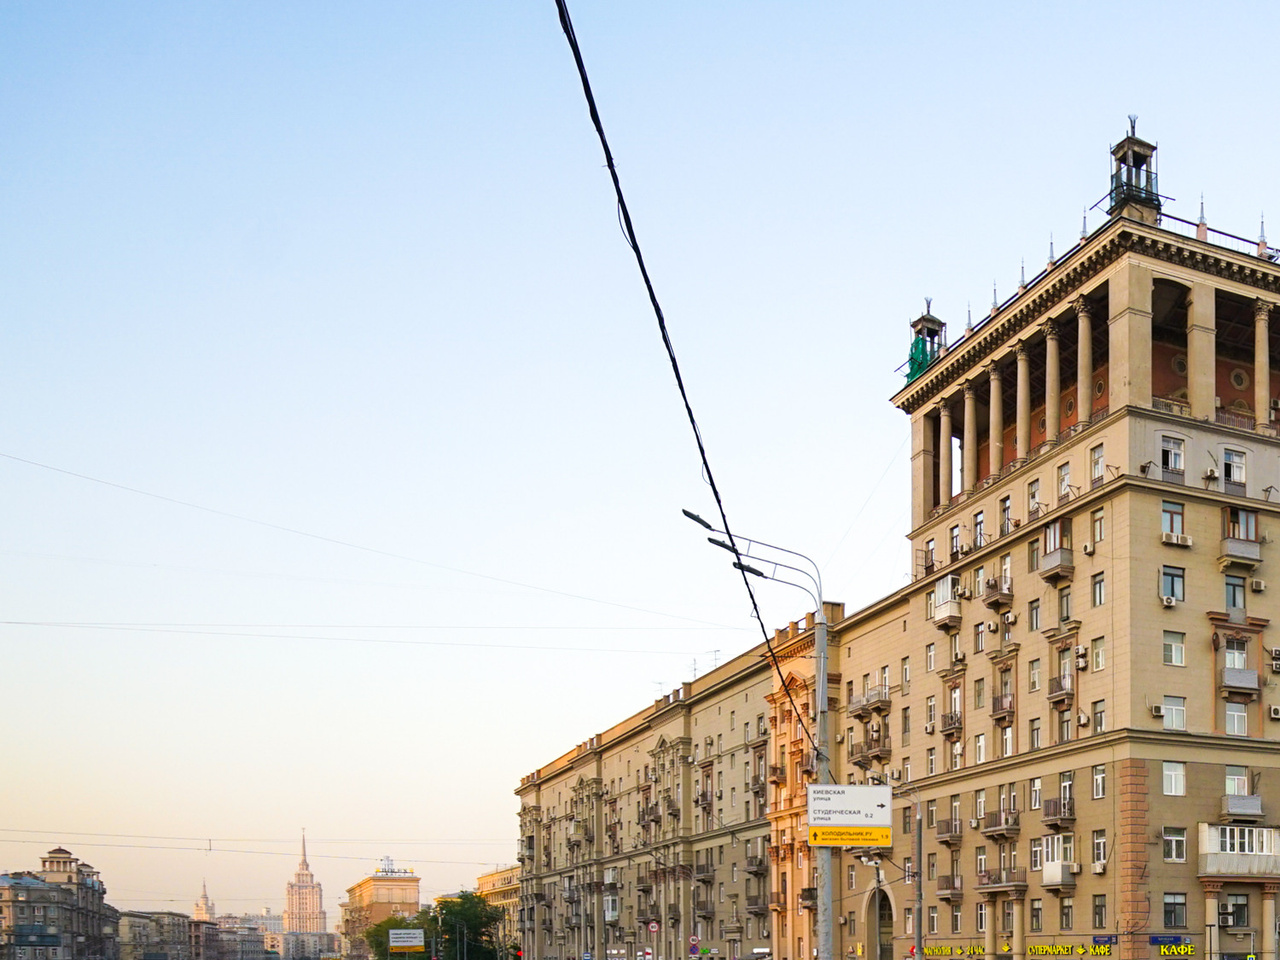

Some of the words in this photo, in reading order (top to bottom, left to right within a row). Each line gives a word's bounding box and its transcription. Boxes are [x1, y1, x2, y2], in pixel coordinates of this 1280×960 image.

[1028, 945, 1073, 955] СУПЕРМАРКЕТ
[1089, 945, 1111, 955] КАФЕ
[1160, 945, 1195, 955] КАФЕ
